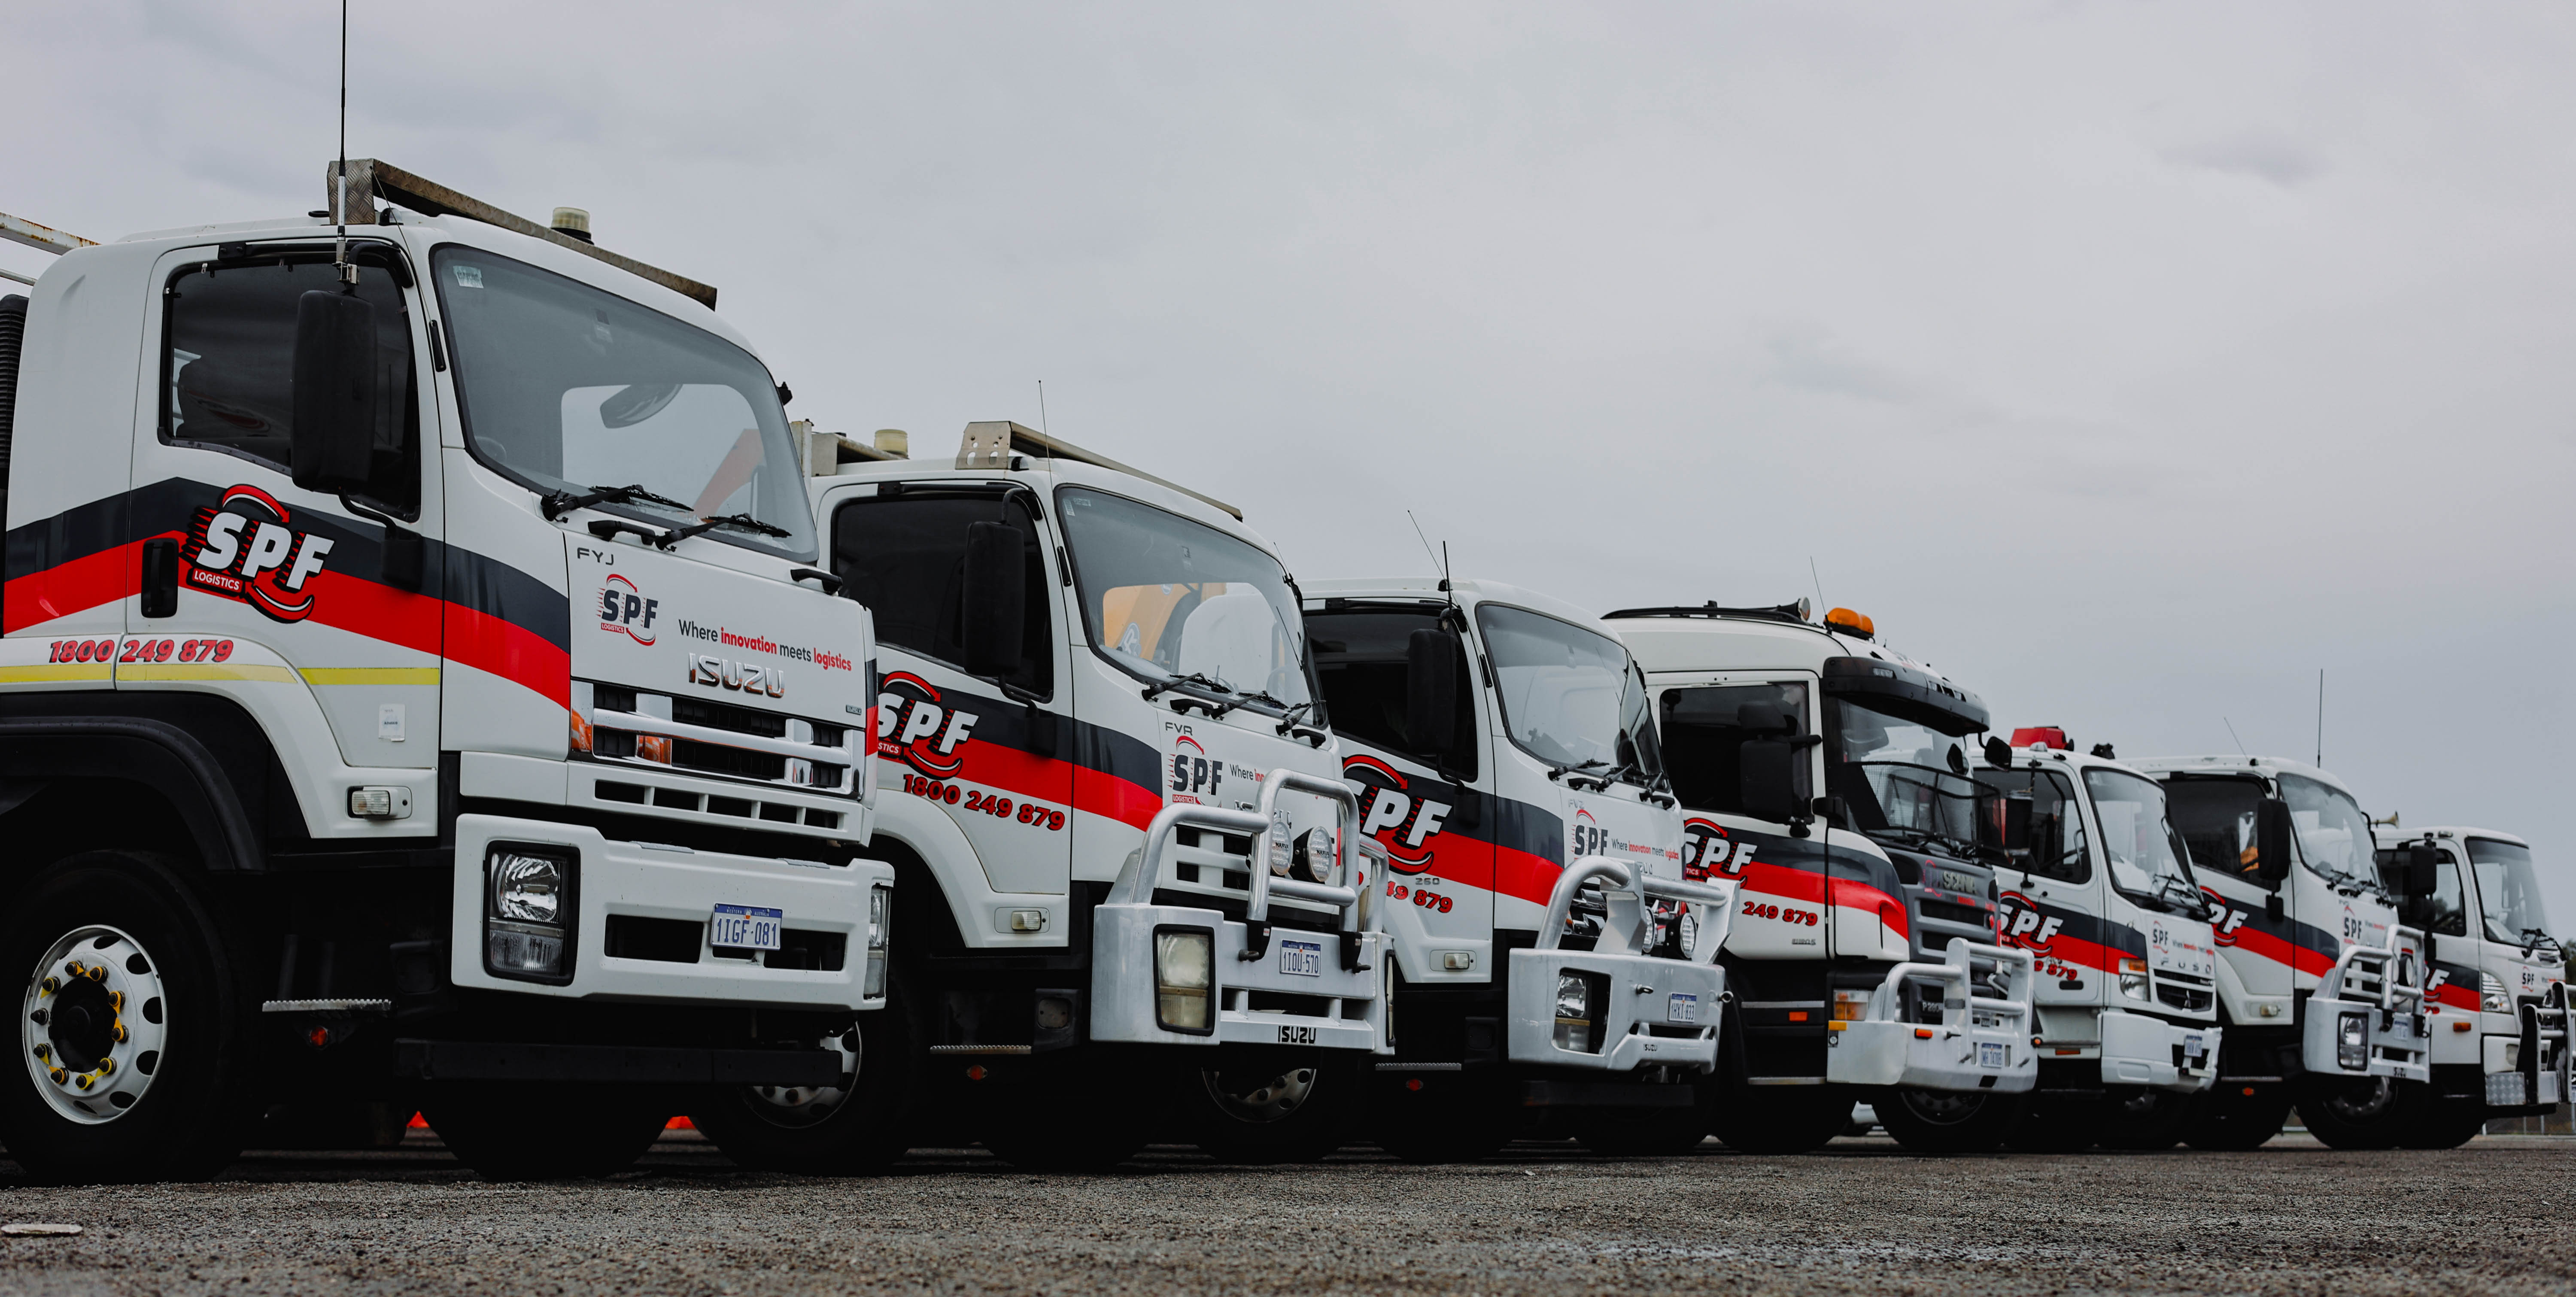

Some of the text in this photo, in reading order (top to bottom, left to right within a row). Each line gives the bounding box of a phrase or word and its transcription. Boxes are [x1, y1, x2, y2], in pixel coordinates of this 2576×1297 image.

[196, 512, 335, 589] SPF
[577, 547, 614, 565] FYJ
[194, 571, 240, 591] LOGISTICS
[601, 589, 658, 629] SPF
[602, 623, 624, 633] LOGISTICS
[49, 639, 234, 664] 1800 249 879
[679, 619, 852, 671] Where innovation meets logistics
[688, 652, 785, 699] ISUZU
[1165, 722, 1193, 736] FVR
[878, 742, 899, 754] STICS
[1173, 755, 1223, 796] SPF
[1230, 764, 1254, 780] Where
[903, 774, 1065, 831] 1800 249 879
[1574, 825, 1608, 856] SPF
[1612, 838, 1679, 861] Where innovation meets logistics
[1387, 881, 1453, 913] 49 879
[1742, 901, 1818, 926] 249 879
[2208, 902, 2248, 934] PF
[2153, 929, 2168, 945] SPF
[2047, 964, 2077, 981] 879
[1278, 1026, 1316, 1044] ISUZU
